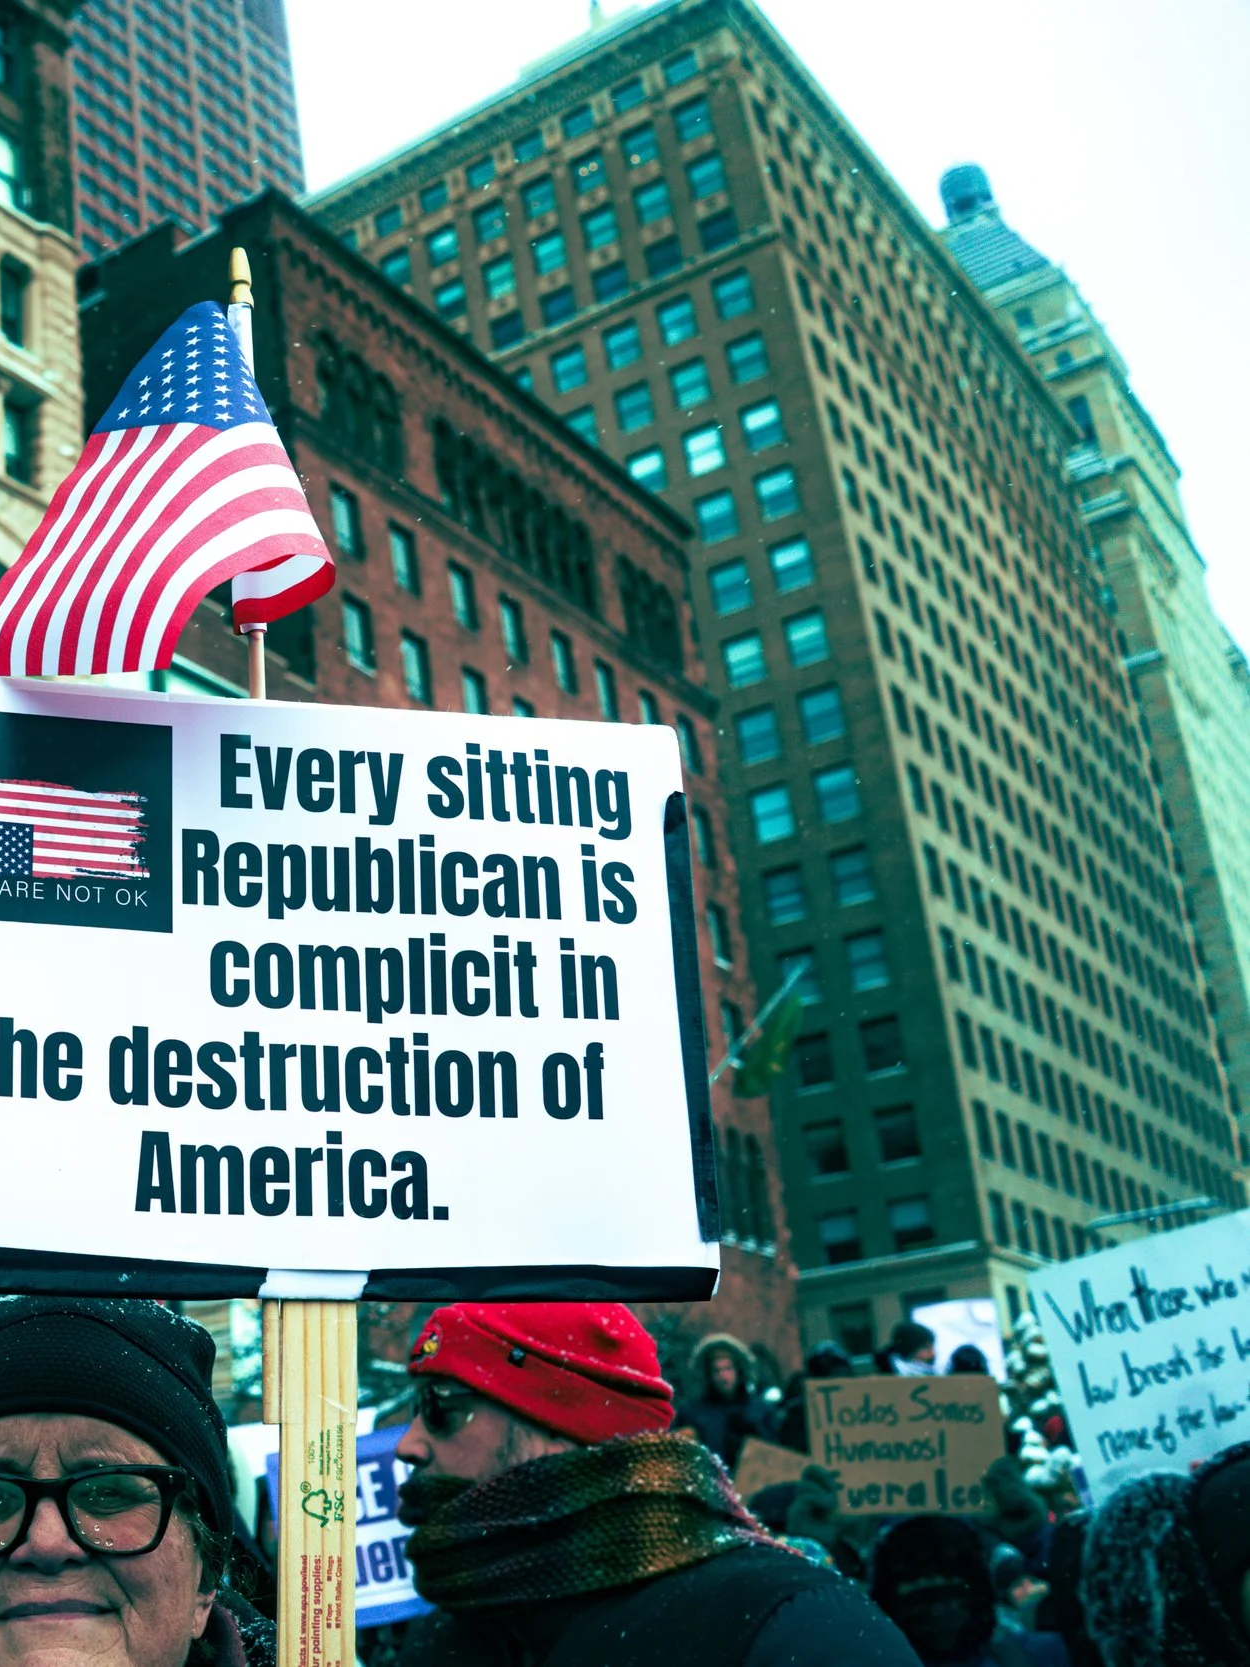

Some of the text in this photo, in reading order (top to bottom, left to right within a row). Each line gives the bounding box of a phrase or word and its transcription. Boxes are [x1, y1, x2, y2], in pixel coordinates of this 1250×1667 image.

[219, 733, 632, 841] Every sitting
[56, 883, 105, 904] NOT
[115, 888, 148, 907] OK
[181, 828, 638, 925] Republican is
[209, 932, 620, 1024] complicit in
[108, 1025, 519, 1119] destruction
[542, 1041, 605, 1120] of
[134, 1130, 450, 1221] America.
[907, 1383, 987, 1426] Somos
[307, 1440, 316, 1465] 100%
[823, 1428, 949, 1467] Humanos!
[333, 1489, 345, 1523] FSC
[312, 1554, 323, 1605] supplies:
[326, 1556, 334, 1575] Rags
[299, 1554, 309, 1635] www.epa.gov/lead
[311, 1608, 323, 1654] painting
